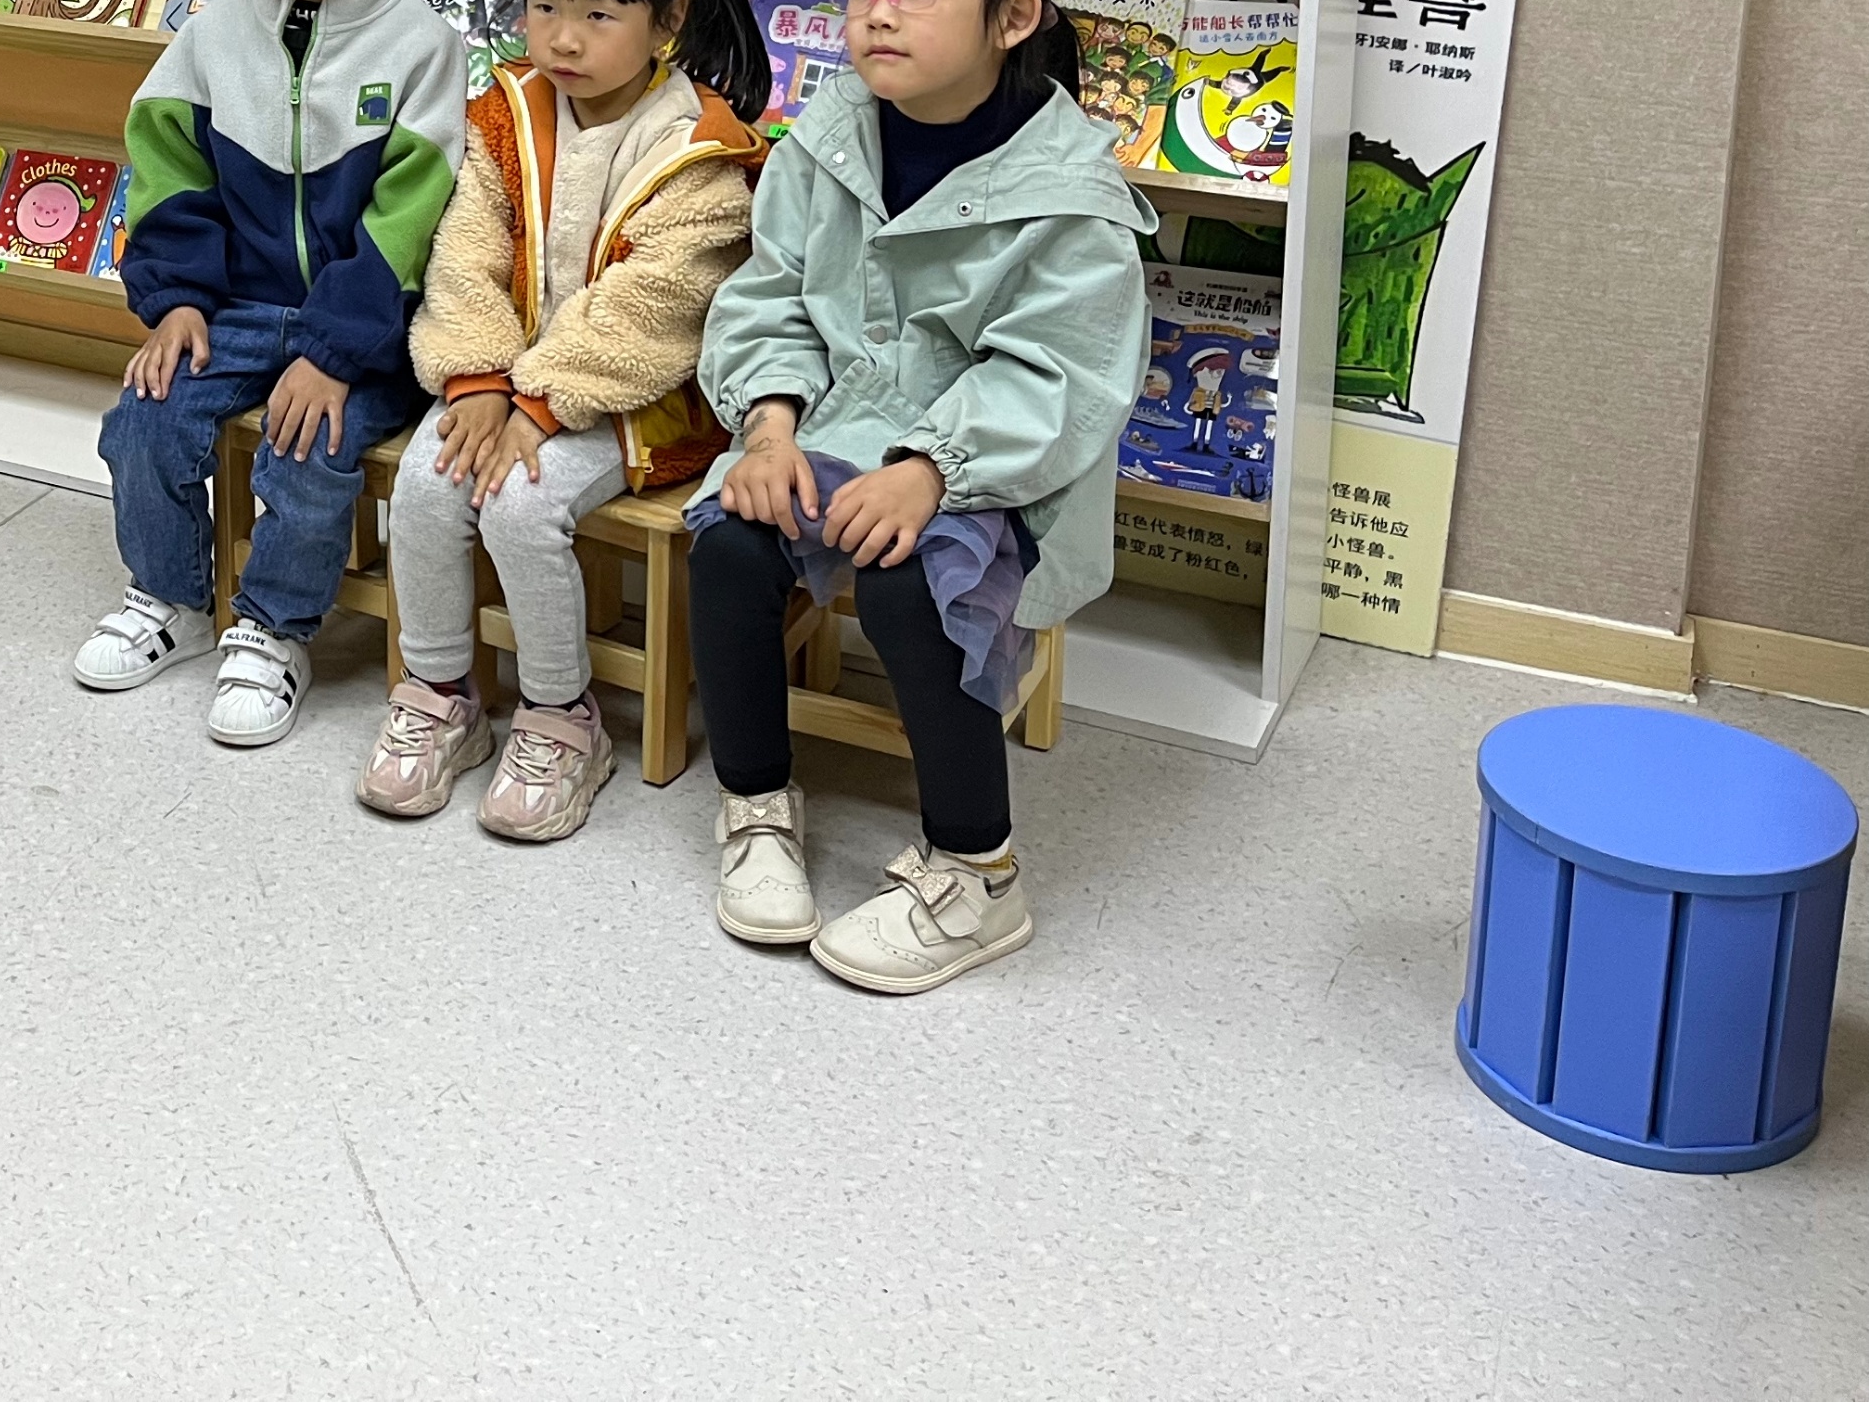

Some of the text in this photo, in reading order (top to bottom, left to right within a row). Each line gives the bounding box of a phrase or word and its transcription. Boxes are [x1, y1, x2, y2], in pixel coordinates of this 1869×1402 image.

[775, 128, 789, 138] 10
[21, 159, 78, 185] Clothes
[1332, 482, 1391, 509] 怪兽展
[1115, 511, 1268, 558] 红色代表愤怒，绿
[1329, 507, 1409, 538] 告诉他应
[1114, 534, 1268, 582] 兽变成了粉红色，
[1321, 582, 1401, 614] 哪一种情
